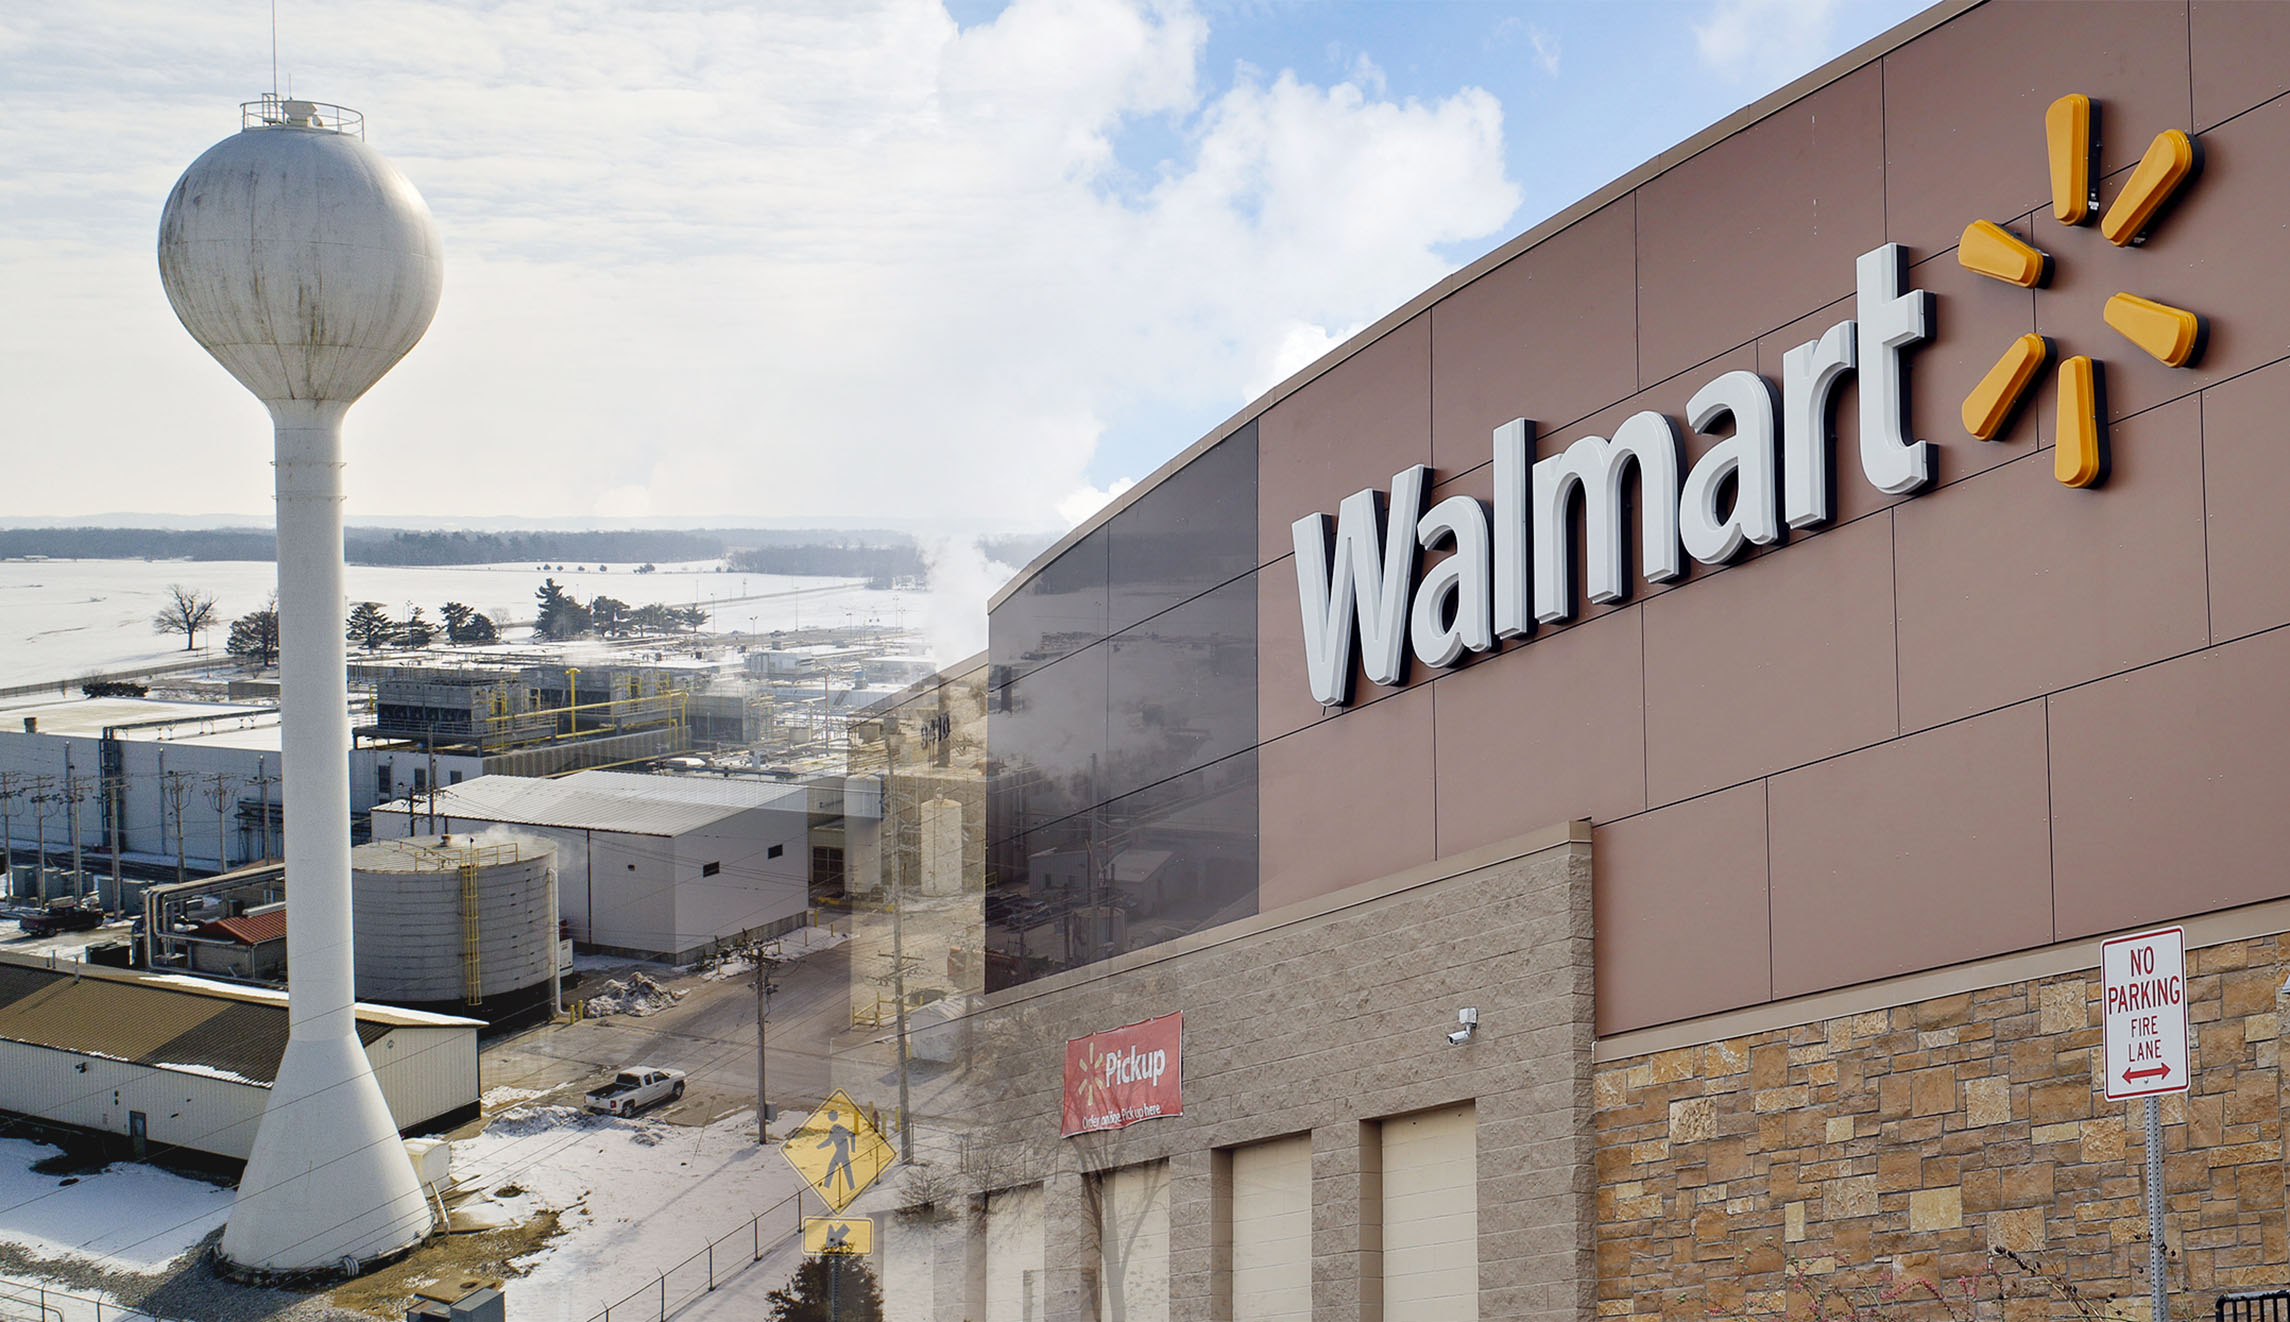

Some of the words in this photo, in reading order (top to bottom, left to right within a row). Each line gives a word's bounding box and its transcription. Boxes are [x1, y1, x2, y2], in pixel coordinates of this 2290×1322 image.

[1291, 242, 1935, 707] Walmart
[2130, 945, 2154, 977] NO
[2108, 975, 2180, 1015] PARKING
[2131, 1015, 2158, 1038] FIRE
[1105, 1045, 1166, 1088] Pickup
[2128, 1039, 2162, 1063] LANE
[1082, 1114, 1100, 1129] Order
[1121, 1106, 1134, 1121] Pick
[1134, 1107, 1144, 1119] up
